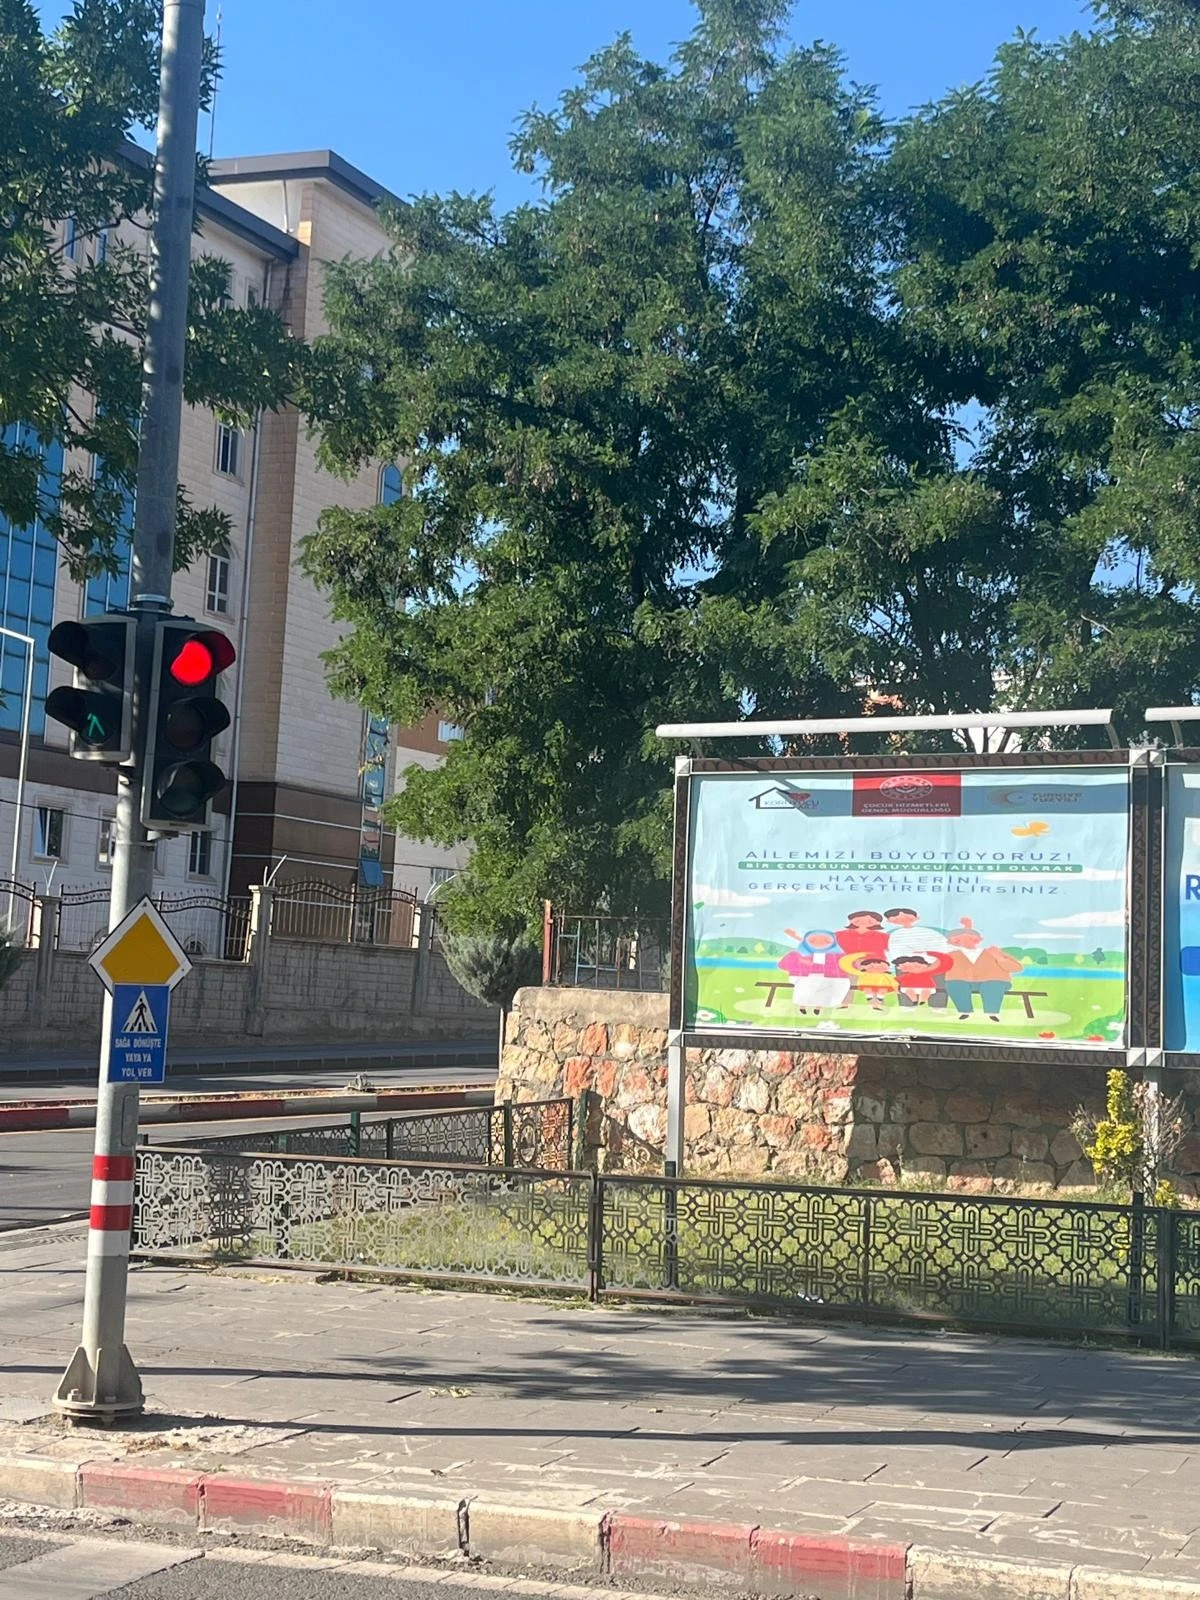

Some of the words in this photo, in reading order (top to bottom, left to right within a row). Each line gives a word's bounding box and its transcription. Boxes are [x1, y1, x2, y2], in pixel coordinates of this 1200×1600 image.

[745, 850, 855, 859] AİLEMİZİ
[870, 850, 1071, 861] BÜYÜTÜYORUZ!
[777, 862, 850, 870] ÇOCUĞUN
[857, 863, 943, 871] KORUYUCU
[950, 863, 1000, 871] AİLESİ
[828, 874, 979, 884] HAYALLERİNİ
[115, 1037, 131, 1048] SAĞA
[133, 1036, 162, 1049] DÖNÜŞTE
[125, 1053, 142, 1062] YAYA
[121, 1067, 136, 1077] YOL
[138, 1067, 153, 1077] VER
